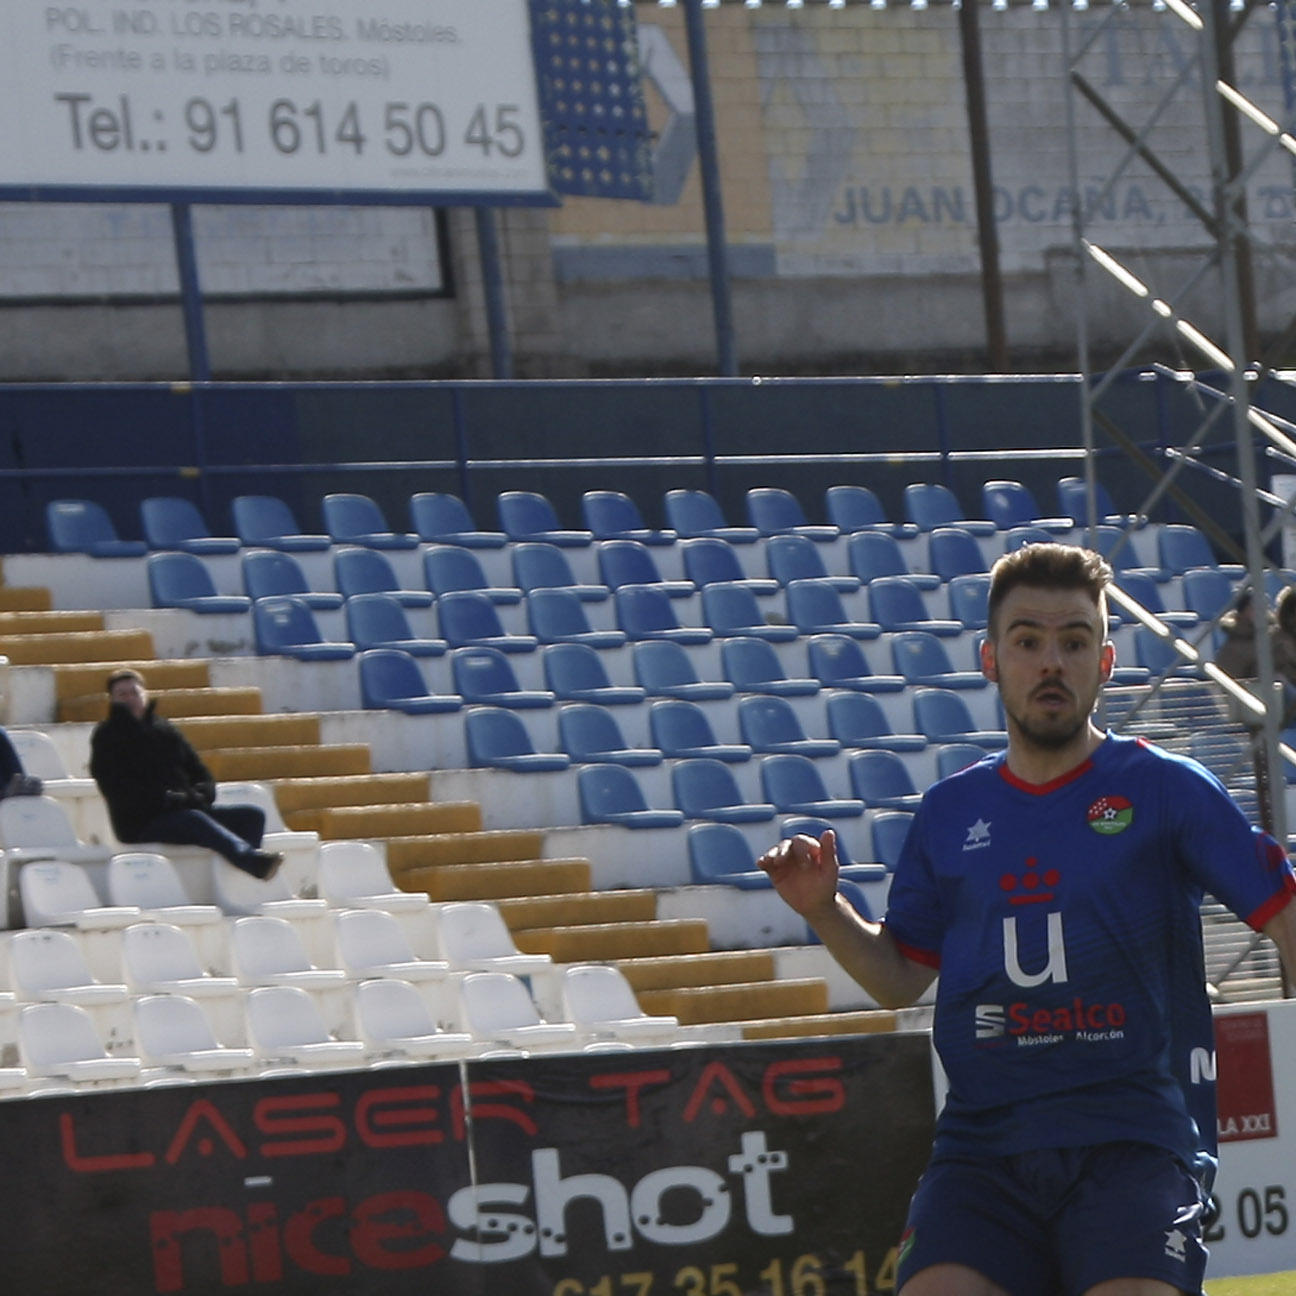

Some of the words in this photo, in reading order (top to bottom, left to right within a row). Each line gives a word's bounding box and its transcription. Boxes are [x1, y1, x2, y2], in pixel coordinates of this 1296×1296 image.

[172, 11, 222, 37] LOS
[152, 55, 168, 71] a
[174, 51, 196, 71] la
[204, 51, 271, 76] plaza
[279, 52, 312, 74] de
[54, 92, 167, 152] Tel.:
[184, 95, 244, 153] 91
[268, 97, 366, 156] 614
[384, 101, 446, 158] 50
[463, 102, 525, 159] 45
[832, 185, 968, 225] JUAN
[1008, 996, 1127, 1036] Sealco
[59, 1078, 539, 1173] LASER
[589, 1056, 847, 1129] TAG
[1238, 1182, 1290, 1239] 05
